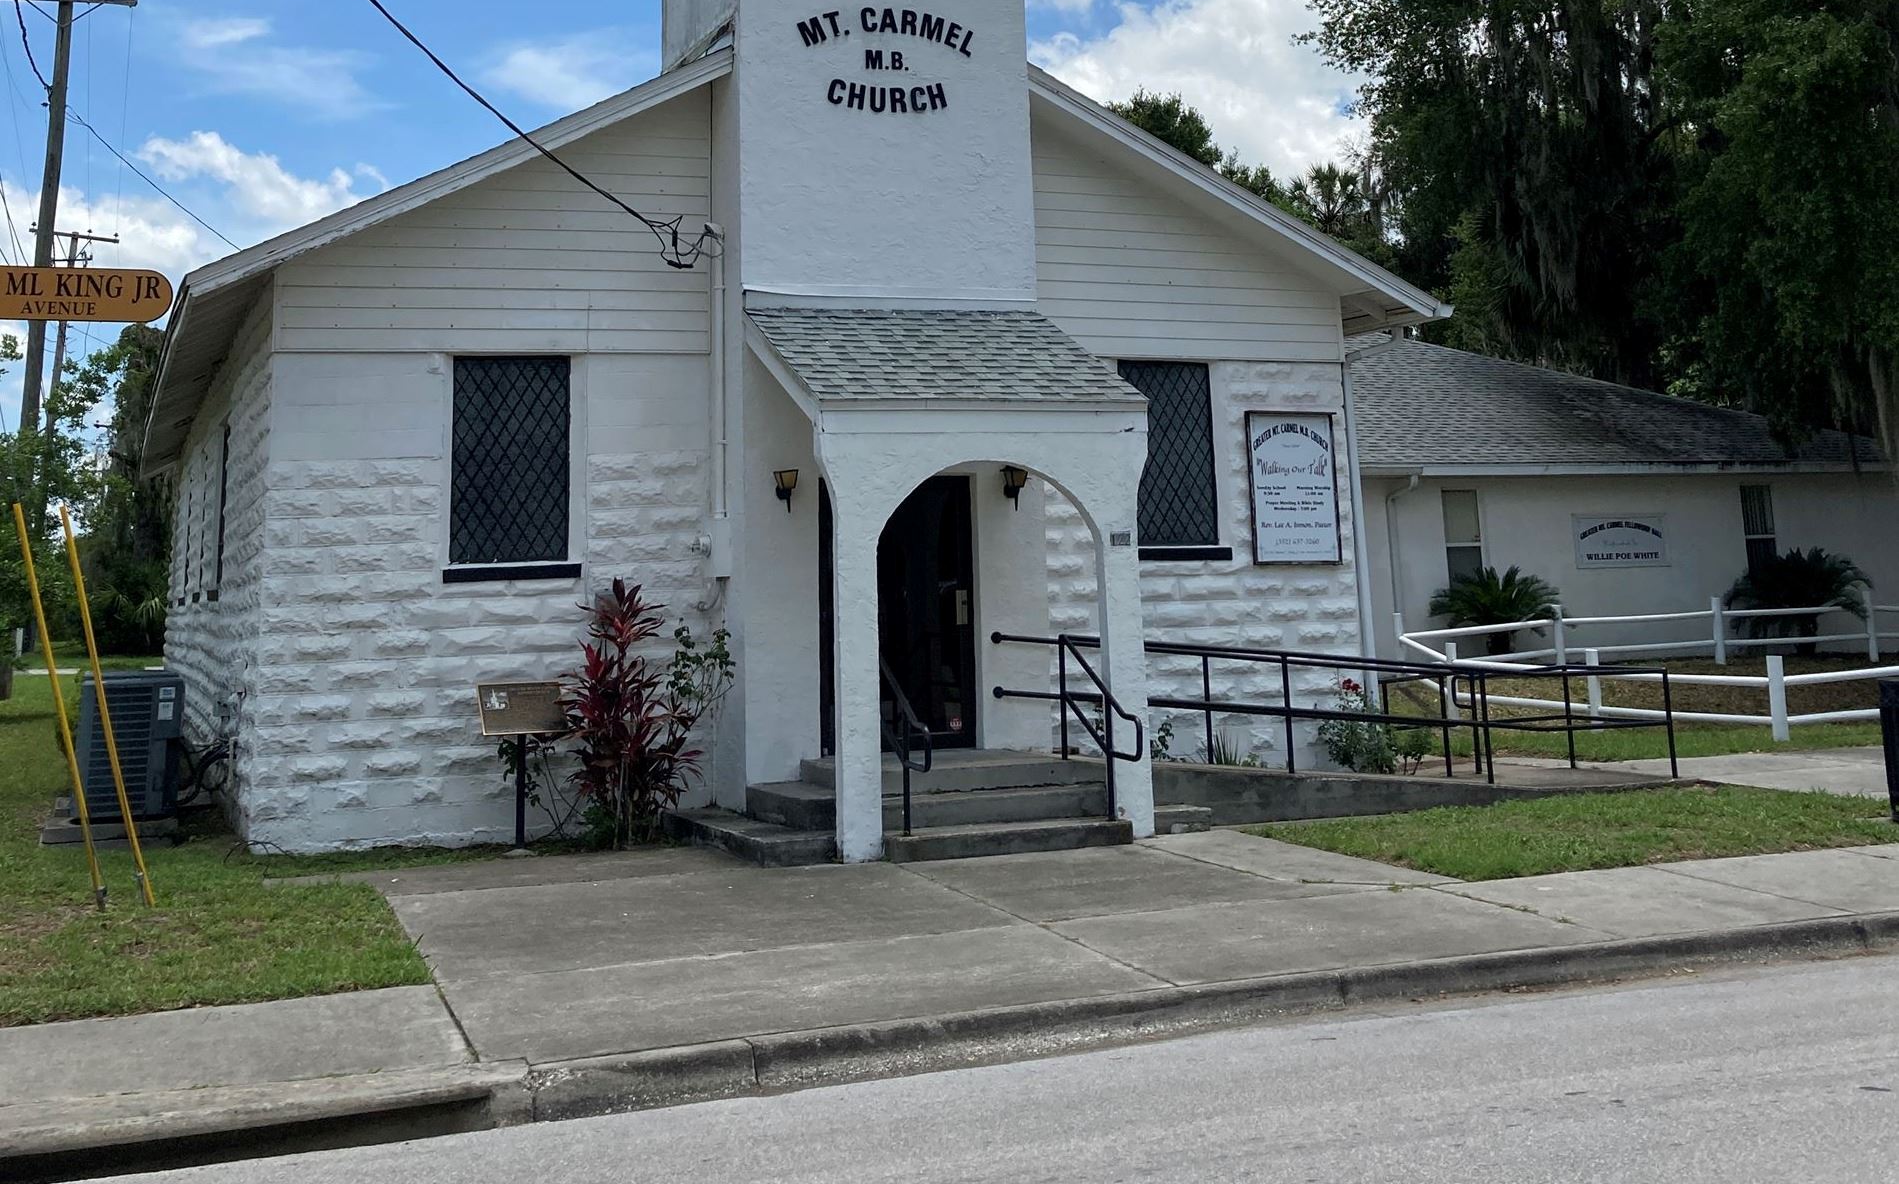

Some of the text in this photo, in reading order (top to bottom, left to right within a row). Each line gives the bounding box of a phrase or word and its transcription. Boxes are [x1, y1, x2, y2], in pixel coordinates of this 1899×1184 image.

[796, 7, 974, 58] MT. CARMEL
[865, 49, 909, 71] M.B.
[827, 78, 948, 114] CHURCH
[6, 272, 160, 303] ML KING JR
[21, 301, 97, 315] AVENUE
[1253, 429, 1271, 451] GREATER
[1280, 423, 1299, 434] CARMEL
[1310, 430, 1328, 452] CHURCH
[1291, 465, 1305, 473] Our
[1586, 551, 1660, 561] WILLIE POE WHITE
